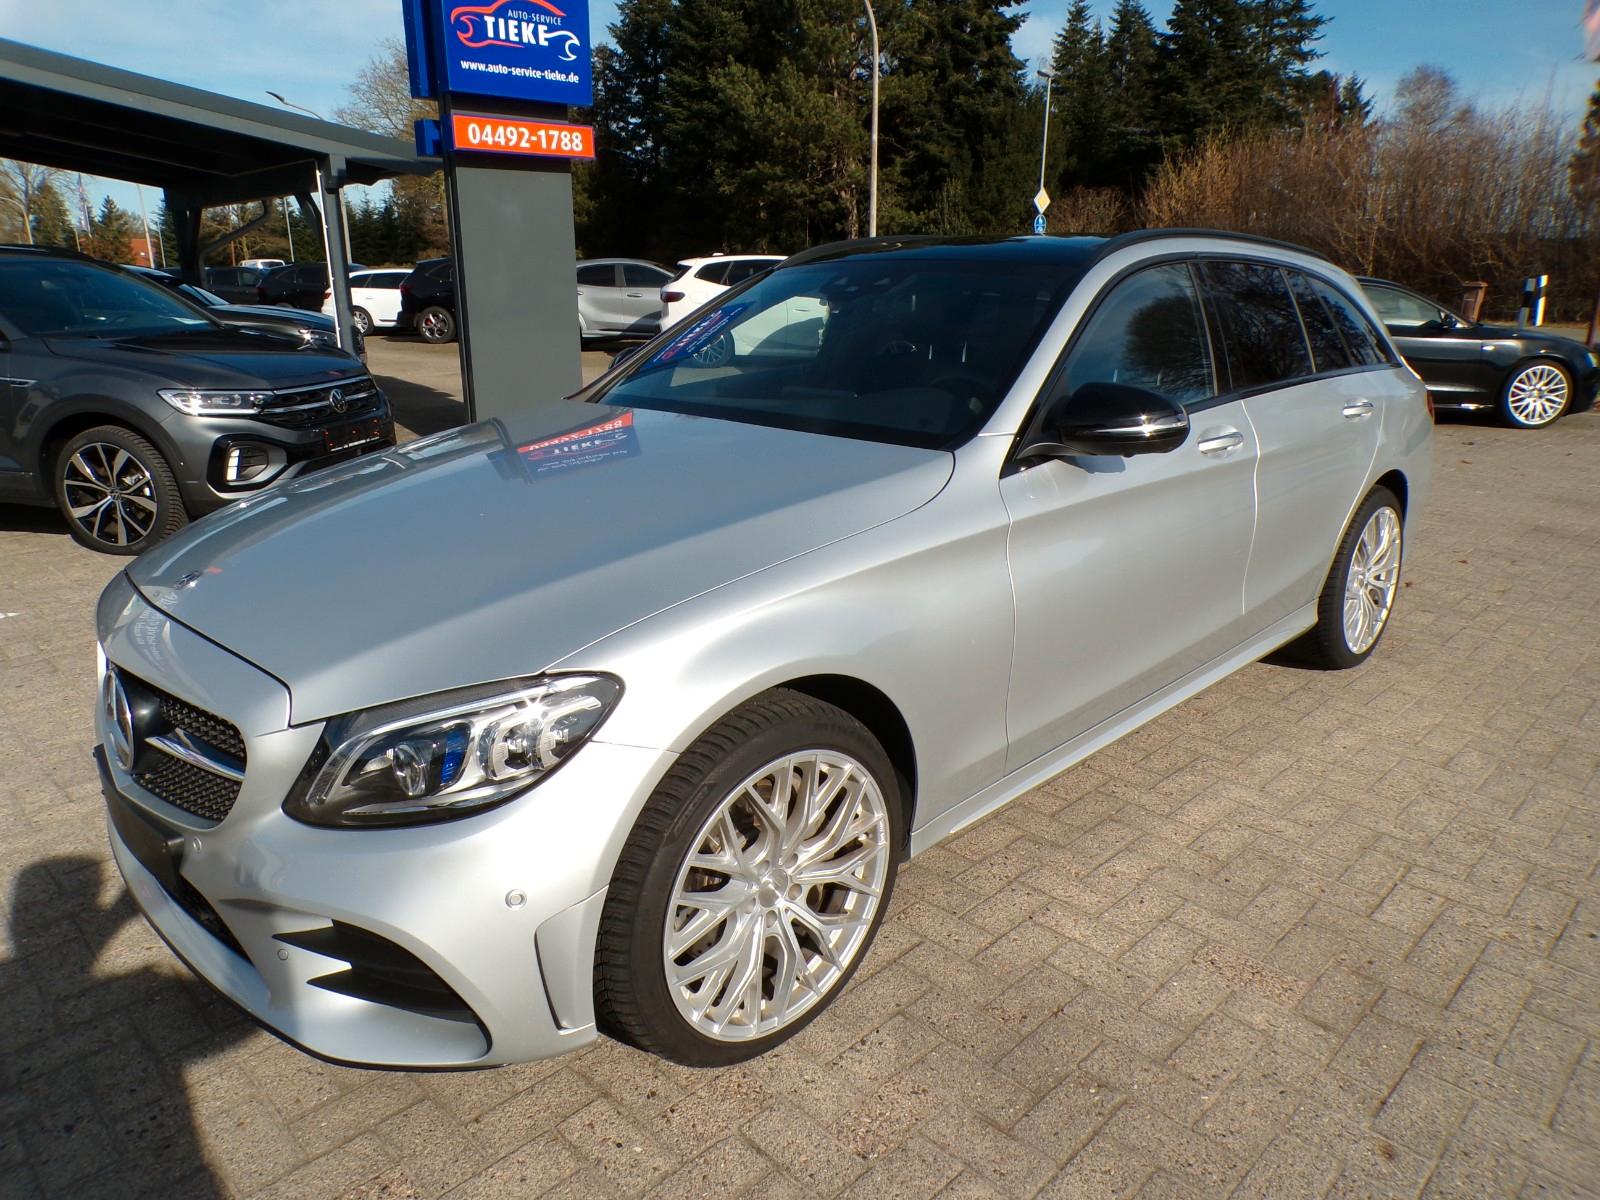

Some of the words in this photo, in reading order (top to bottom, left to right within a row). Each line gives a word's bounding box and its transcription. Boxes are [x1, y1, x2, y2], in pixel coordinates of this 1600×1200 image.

[508, 9, 561, 25] AUTO-SERVICE
[484, 16, 548, 46] TIEKE
[461, 60, 579, 83] www.auto-service-tieke.de
[468, 123, 582, 151] 04492-1788
